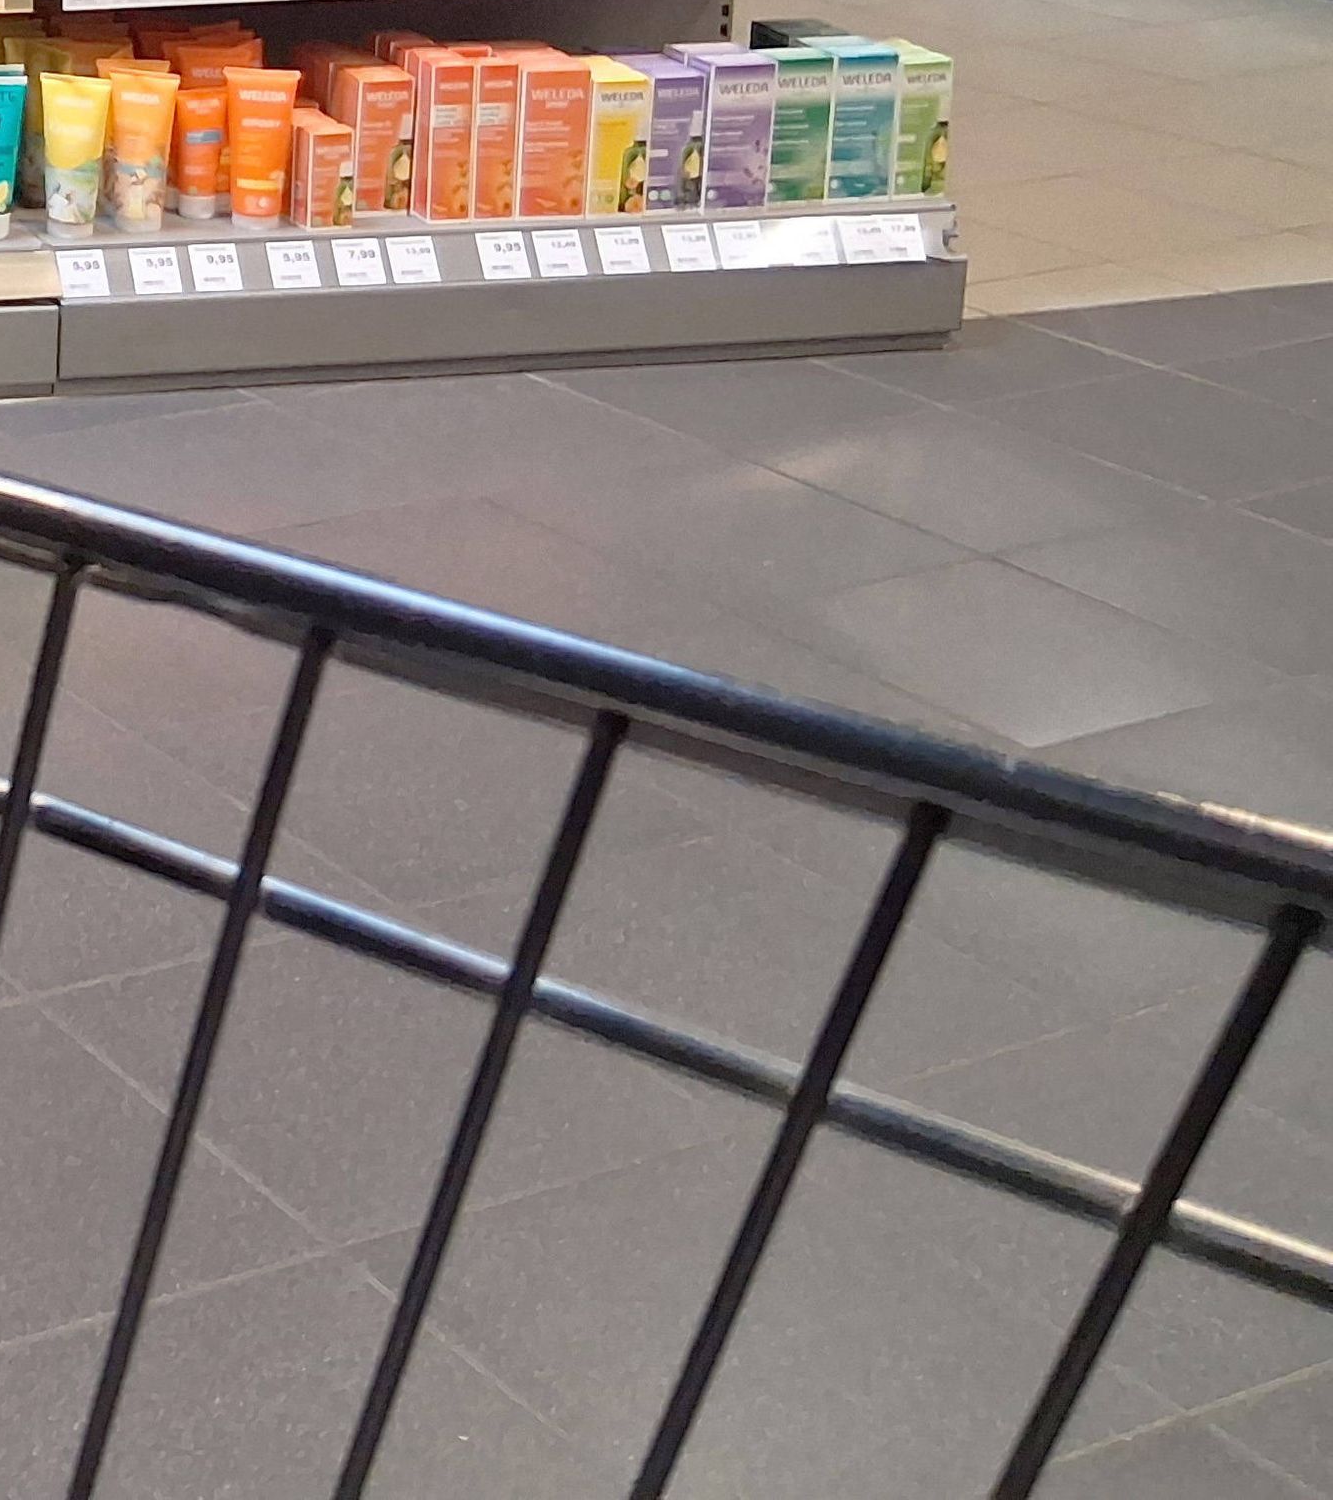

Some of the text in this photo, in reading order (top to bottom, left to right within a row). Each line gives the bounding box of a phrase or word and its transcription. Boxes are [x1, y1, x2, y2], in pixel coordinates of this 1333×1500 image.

[778, 76, 829, 88] WELEDA
[842, 73, 892, 86] WELEDA
[907, 73, 949, 84] WELEDA
[718, 82, 769, 95] WELEDA
[239, 90, 287, 102] WELEDA
[531, 88, 585, 102] WELEDA
[601, 92, 644, 102] WELEDA
